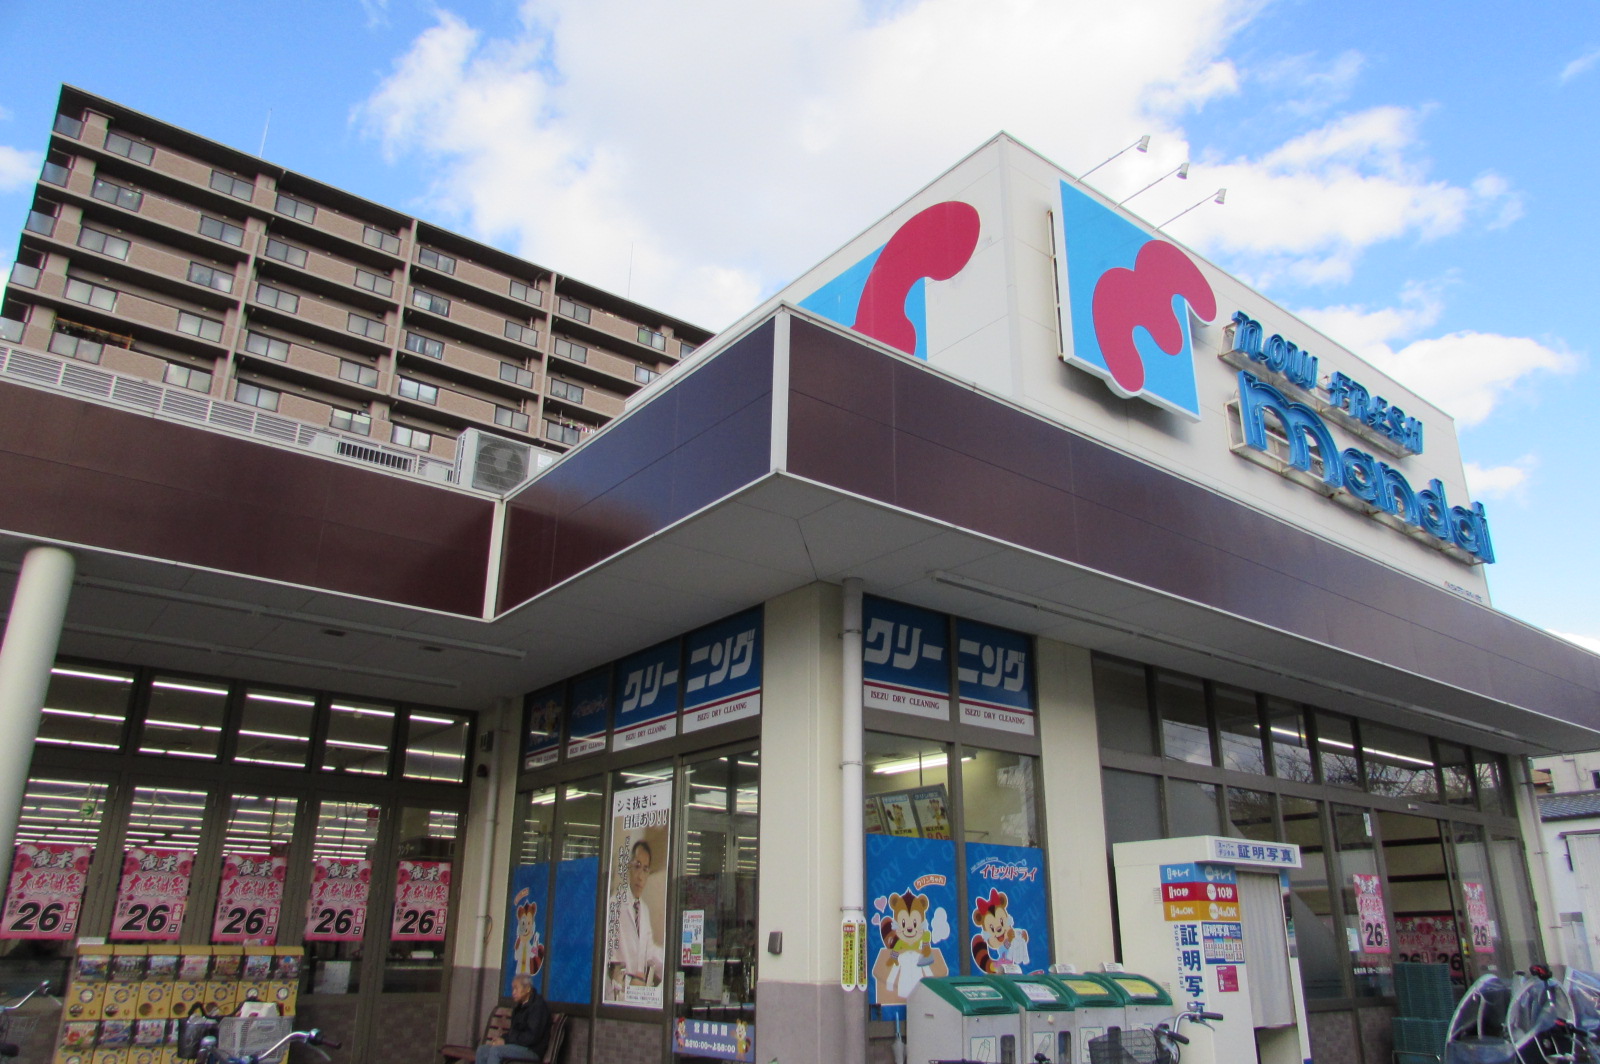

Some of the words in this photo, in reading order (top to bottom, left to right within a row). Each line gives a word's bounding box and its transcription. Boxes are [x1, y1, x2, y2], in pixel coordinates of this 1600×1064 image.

[1326, 371, 1423, 455] FRESH
[1237, 370, 1495, 563] mandai
[697, 712, 710, 722] ISEZU
[711, 707, 721, 718] DRY
[723, 701, 747, 715] CLEANING
[870, 691, 889, 701] ISEZU
[892, 695, 906, 704] DRY
[909, 699, 940, 710] CLEANING
[964, 708, 981, 718] ISEZU
[983, 711, 996, 720] DRY
[998, 714, 1025, 726] CLEANING
[625, 731, 638, 741] ISEZU
[638, 728, 646, 738] DRY
[647, 723, 667, 735] CLEANING
[617, 794, 657, 812] シミ抜きに
[1238, 845, 1293, 863] 証明写真
[9, 901, 65, 932] 26
[120, 903, 171, 932] 26
[222, 907, 267, 935] 26
[313, 907, 353, 934] 26
[400, 909, 437, 935] 26
[1366, 922, 1383, 946] 26
[1474, 925, 1488, 945] 26
[693, 1022, 728, 1037] 営業時間
